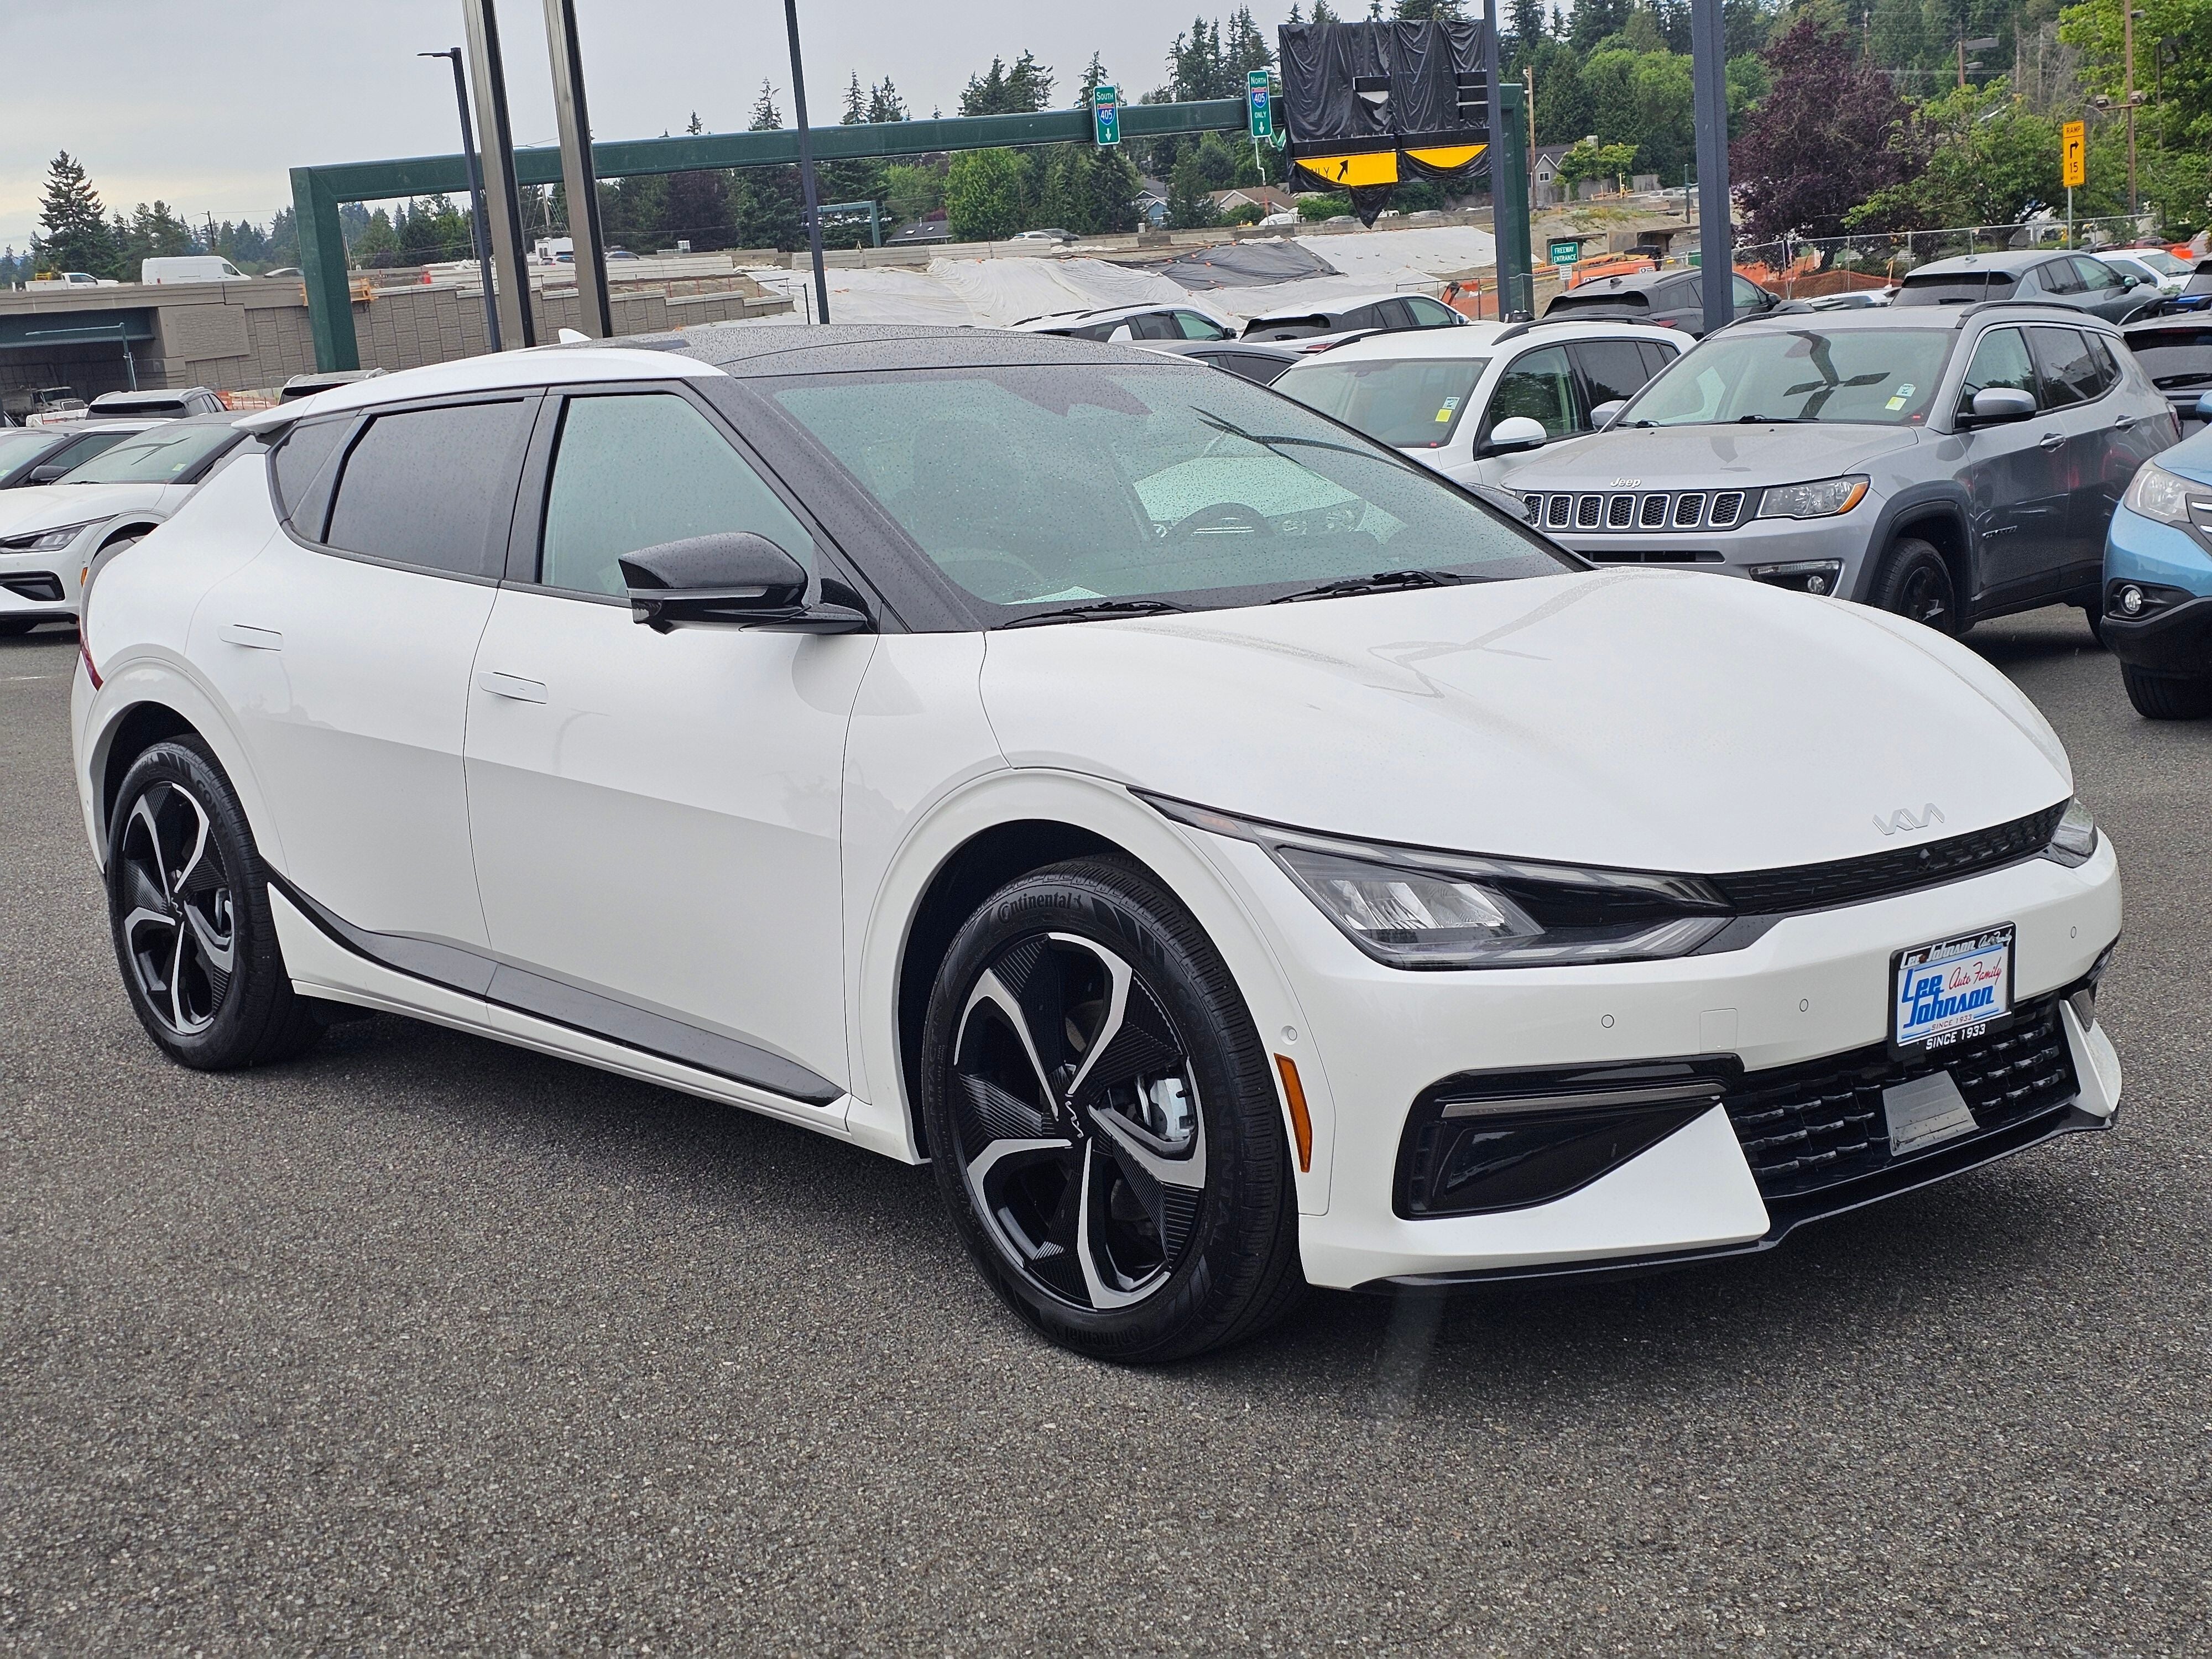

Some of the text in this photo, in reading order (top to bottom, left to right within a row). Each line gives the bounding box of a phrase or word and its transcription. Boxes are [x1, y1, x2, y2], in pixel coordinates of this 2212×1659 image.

[1251, 76, 1266, 85] NORTH
[1096, 92, 1114, 101] SOUTH
[1254, 93, 1265, 103] 405
[1100, 109, 1113, 120] 405
[2070, 161, 2078, 173] 15
[1554, 246, 1574, 254] FREEWAY
[1553, 254, 1577, 262] ENTRANCE
[1610, 477, 1642, 489] Jeep
[1872, 802, 1945, 836] KIA
[997, 891, 1072, 924] Continental
[1926, 940, 1976, 962] Johnson
[1901, 956, 2002, 1003] Lee Auto Family
[1903, 985, 1994, 1029] Johnson
[1931, 1014, 1973, 1031] SINCE 1933
[1926, 1023, 1986, 1050] SINCE 1933
